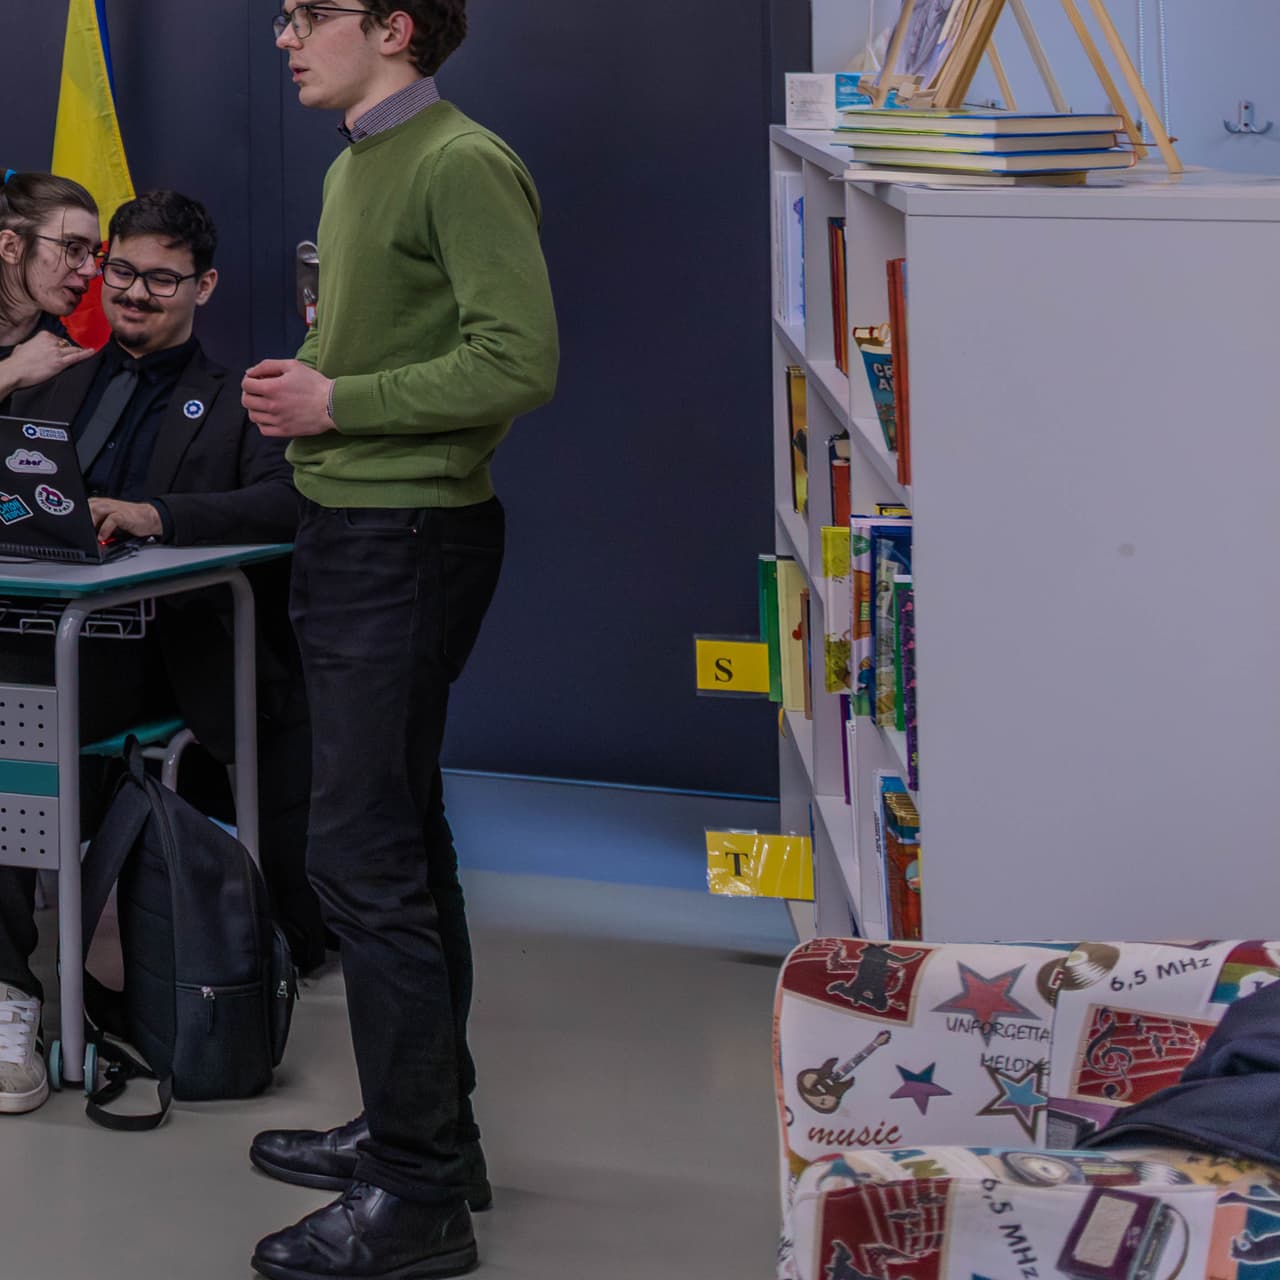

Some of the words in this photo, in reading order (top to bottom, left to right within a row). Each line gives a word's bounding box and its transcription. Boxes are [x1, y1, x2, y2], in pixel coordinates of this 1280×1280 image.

[714, 657, 734, 683] S
[724, 852, 748, 878] T
[1110, 969, 1147, 993] 6,5
[1157, 956, 1212, 980] MHz
[808, 1120, 903, 1147] music
